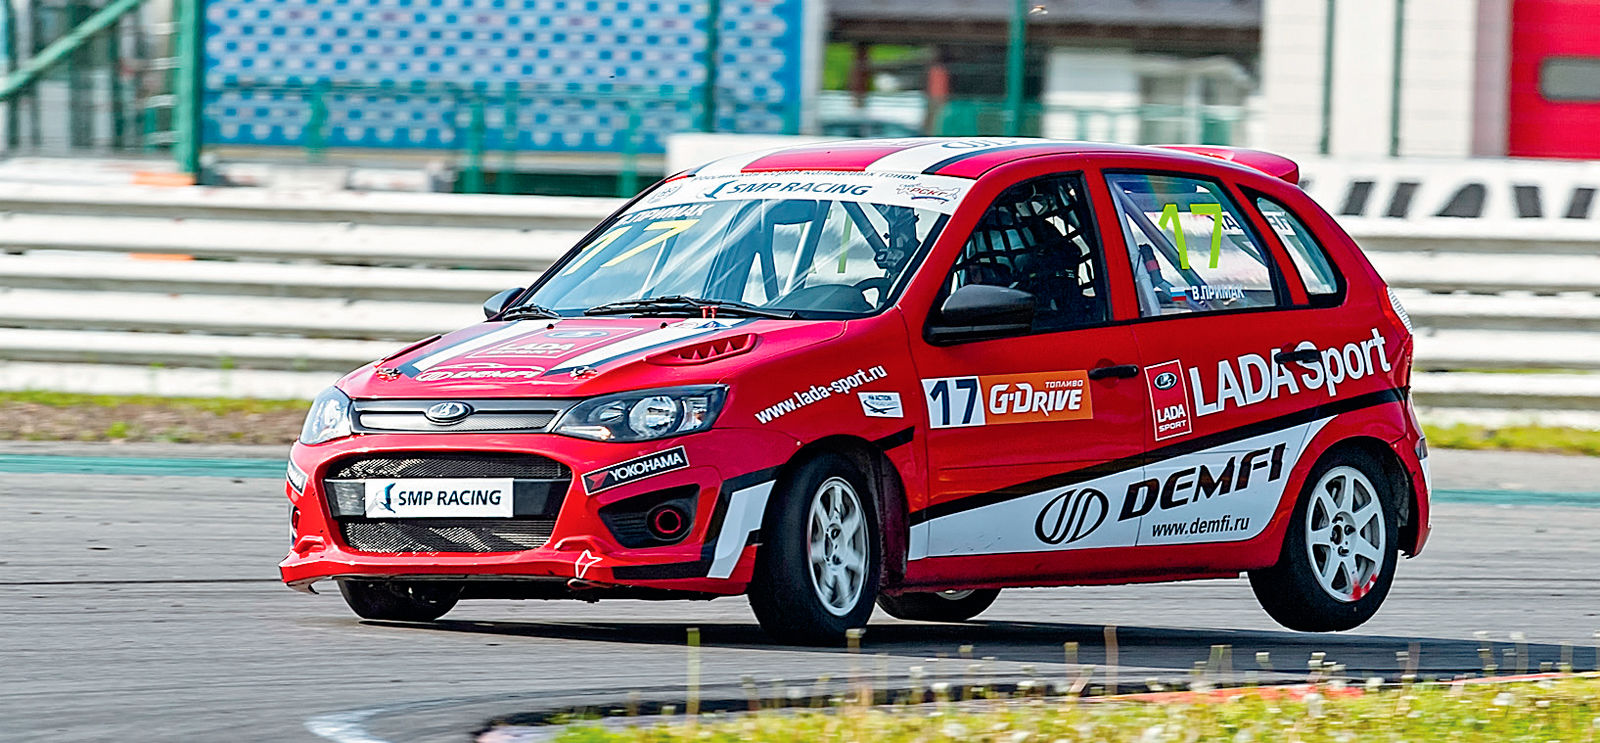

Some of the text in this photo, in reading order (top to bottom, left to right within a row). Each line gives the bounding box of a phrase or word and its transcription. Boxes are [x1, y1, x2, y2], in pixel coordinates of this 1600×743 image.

[727, 182, 873, 197] SMP RACING
[561, 218, 701, 277] 17
[1158, 203, 1223, 270] 17
[1044, 379, 1084, 389] ТОПЛИВО
[1188, 327, 1392, 417] LADA Sport
[754, 365, 888, 425] www.lada-sport.ru
[930, 378, 978, 426] 17
[1157, 404, 1186, 423] LADA
[1158, 420, 1187, 432] SPORT
[609, 452, 683, 481] YOKOHAMA
[1117, 442, 1286, 521] DEMFI
[398, 490, 501, 506] SMP RACING
[1152, 515, 1250, 537] www.demfi.ru
